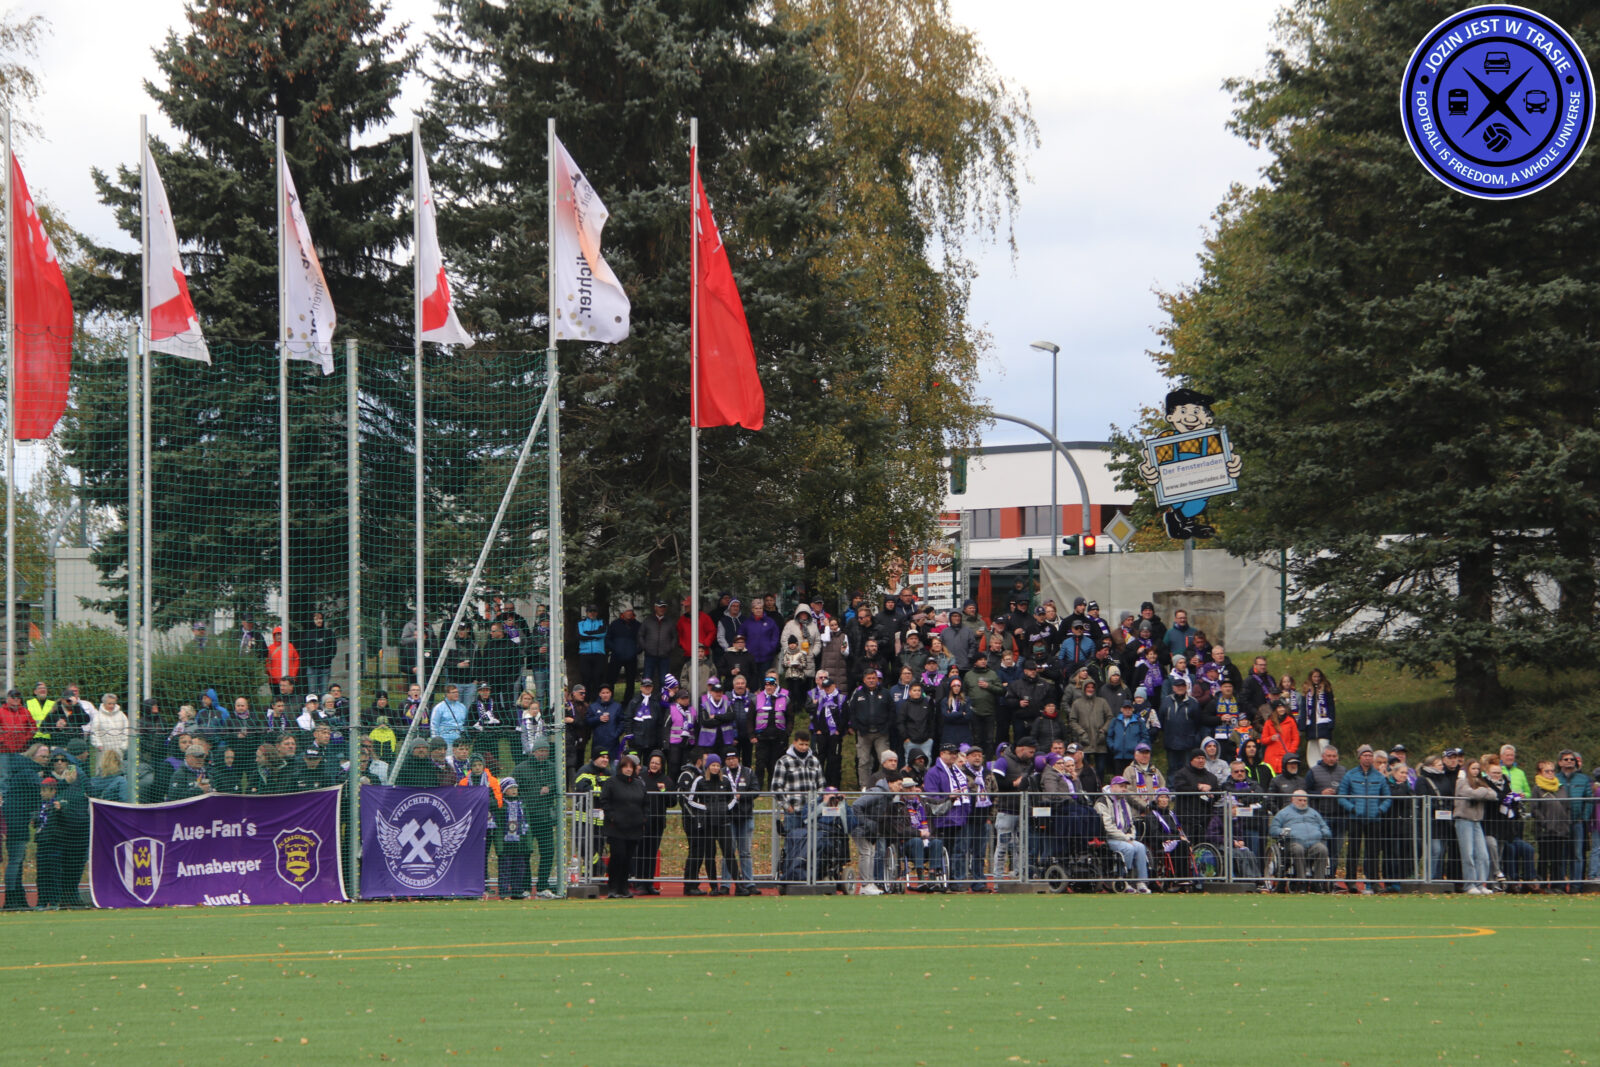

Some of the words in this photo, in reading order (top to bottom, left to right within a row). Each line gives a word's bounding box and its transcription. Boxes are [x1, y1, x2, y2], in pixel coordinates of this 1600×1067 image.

[1162, 468, 1175, 476] Der
[1176, 458, 1223, 471] Fensterladen
[392, 796, 450, 823] VEILCHEN-BIKER
[177, 858, 261, 877] Annaberger
[389, 859, 398, 872] FC
[397, 871, 436, 887] ERZGEBIRGE
[436, 859, 449, 877] AUE
[136, 876, 152, 886] AUE
